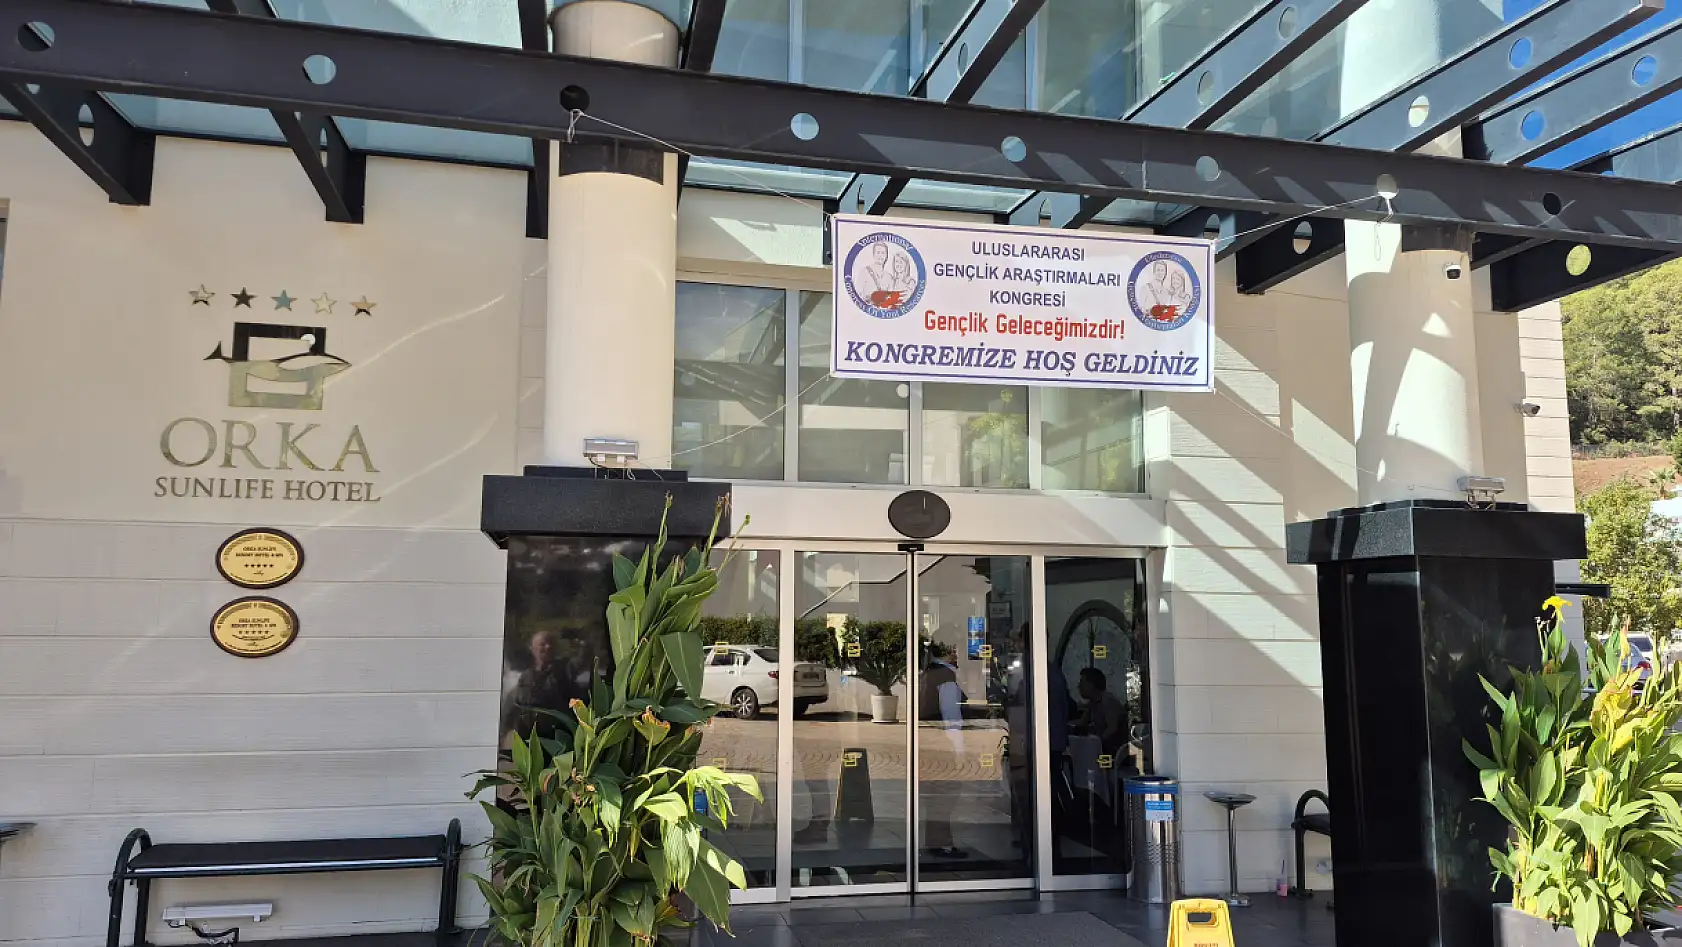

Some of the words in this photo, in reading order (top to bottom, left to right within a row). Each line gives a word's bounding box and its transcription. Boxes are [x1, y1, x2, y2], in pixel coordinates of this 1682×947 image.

[972, 241, 1085, 261] ULUSLARARASI
[934, 263, 999, 282] GENÇLİK
[1003, 268, 1121, 286] ARAŞTIRMALARI
[990, 290, 1066, 307] KONGRESİ
[925, 310, 989, 336] Gençlik
[997, 314, 1125, 341] Geleceğimizdir!
[844, 341, 1016, 369] KONGREMİZE
[1023, 350, 1077, 377] HOŞ
[1084, 350, 1199, 375] GELDİNİZ
[159, 416, 381, 473] ORKA
[154, 476, 275, 499] SUNLIFE
[282, 479, 381, 502] HOTEL
